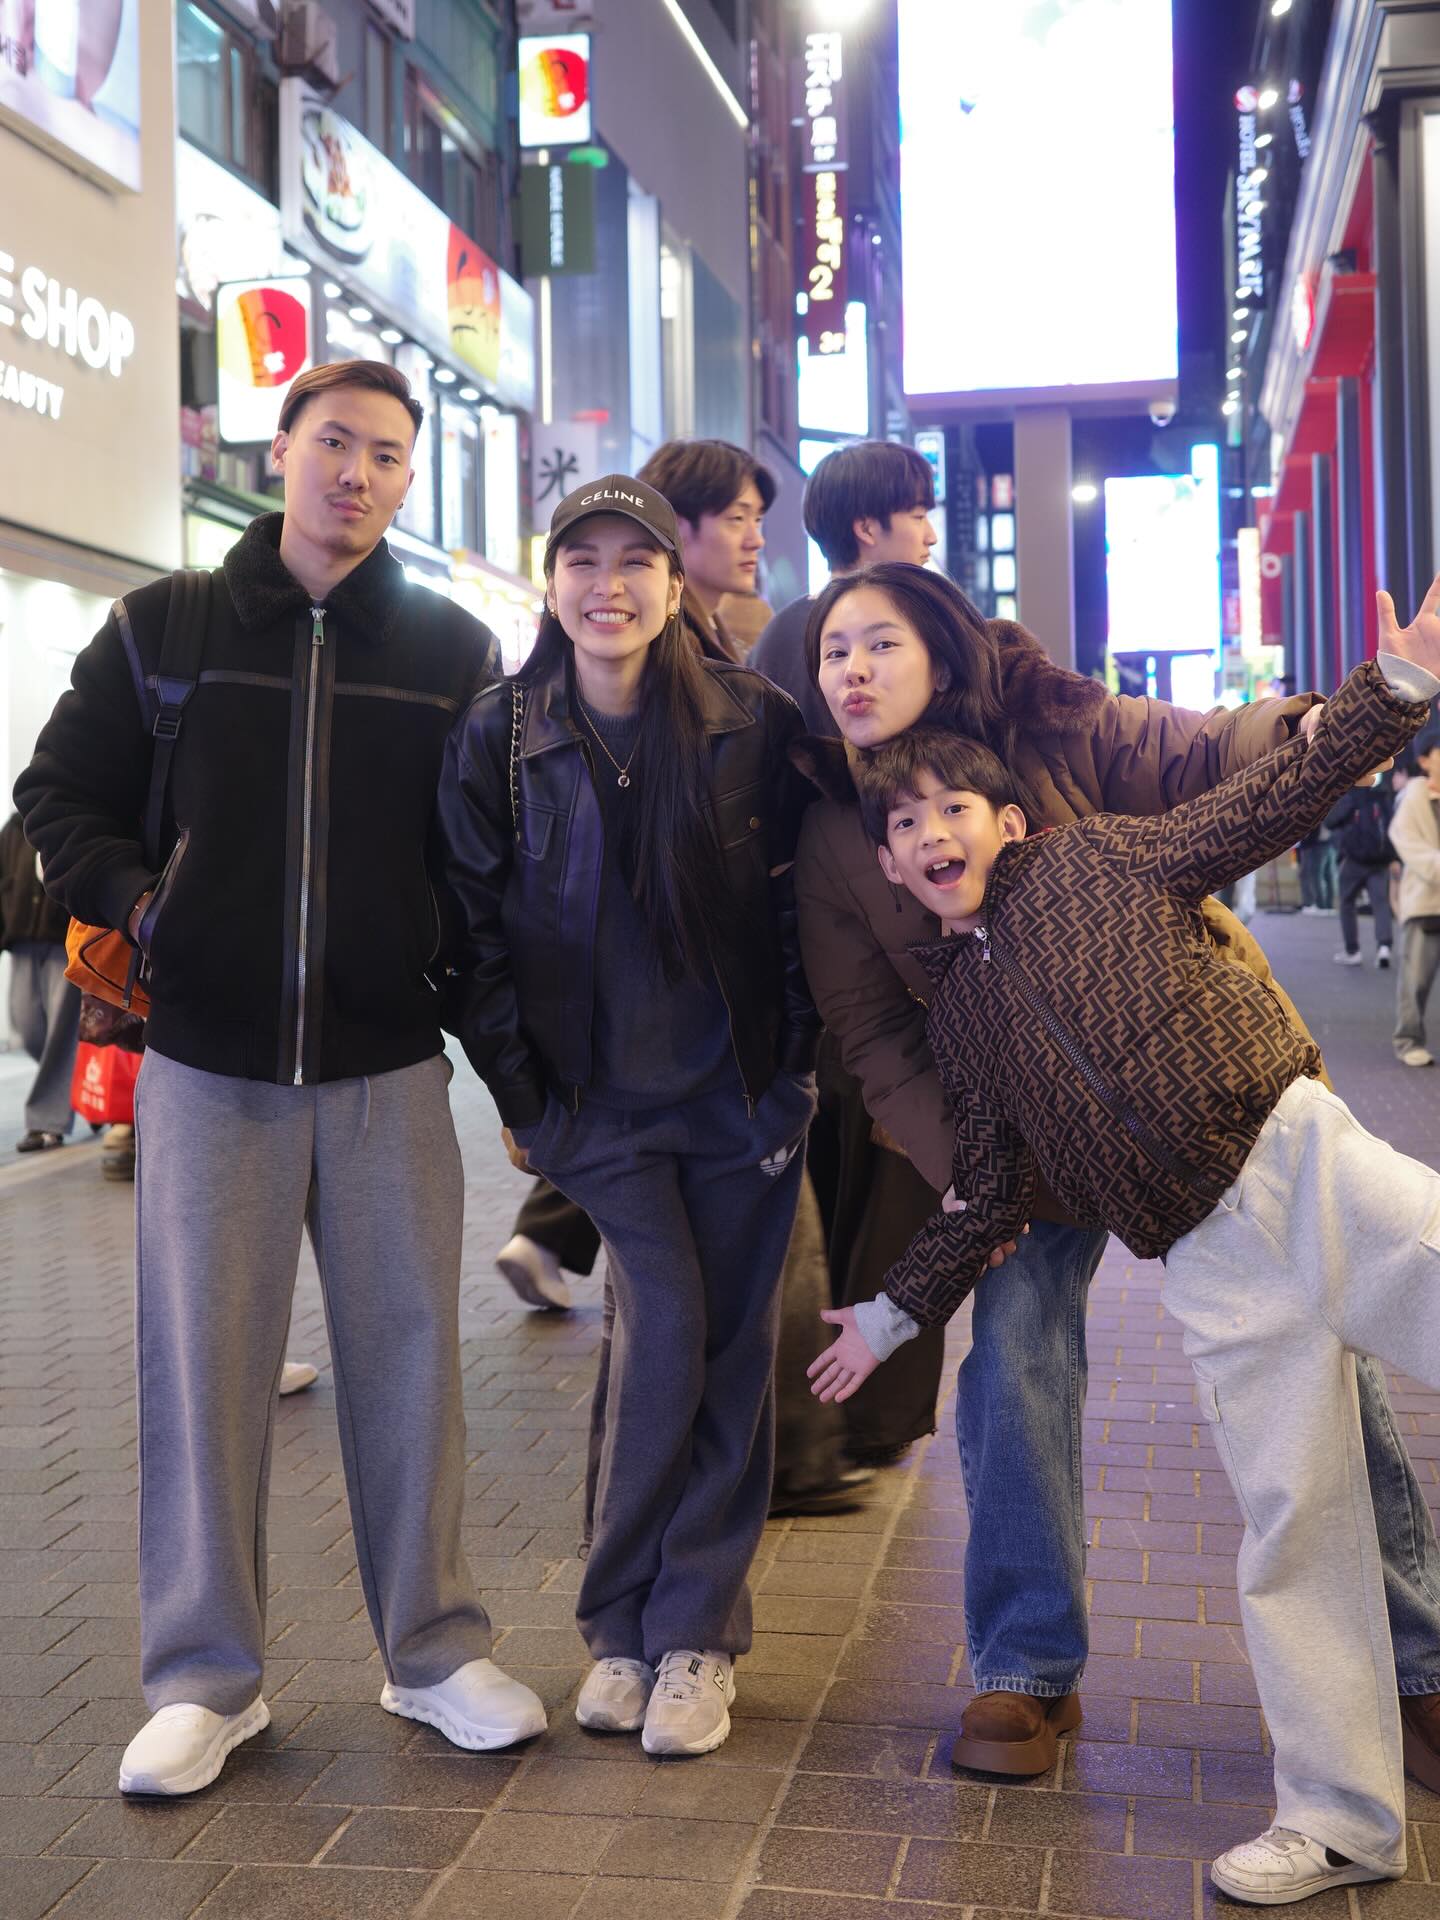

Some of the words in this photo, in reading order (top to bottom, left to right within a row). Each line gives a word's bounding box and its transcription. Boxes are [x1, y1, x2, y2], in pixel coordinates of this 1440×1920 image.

[21, 266, 135, 378] SHOP
[0, 360, 65, 420] AUTY
[580, 489, 645, 508] CELINE
